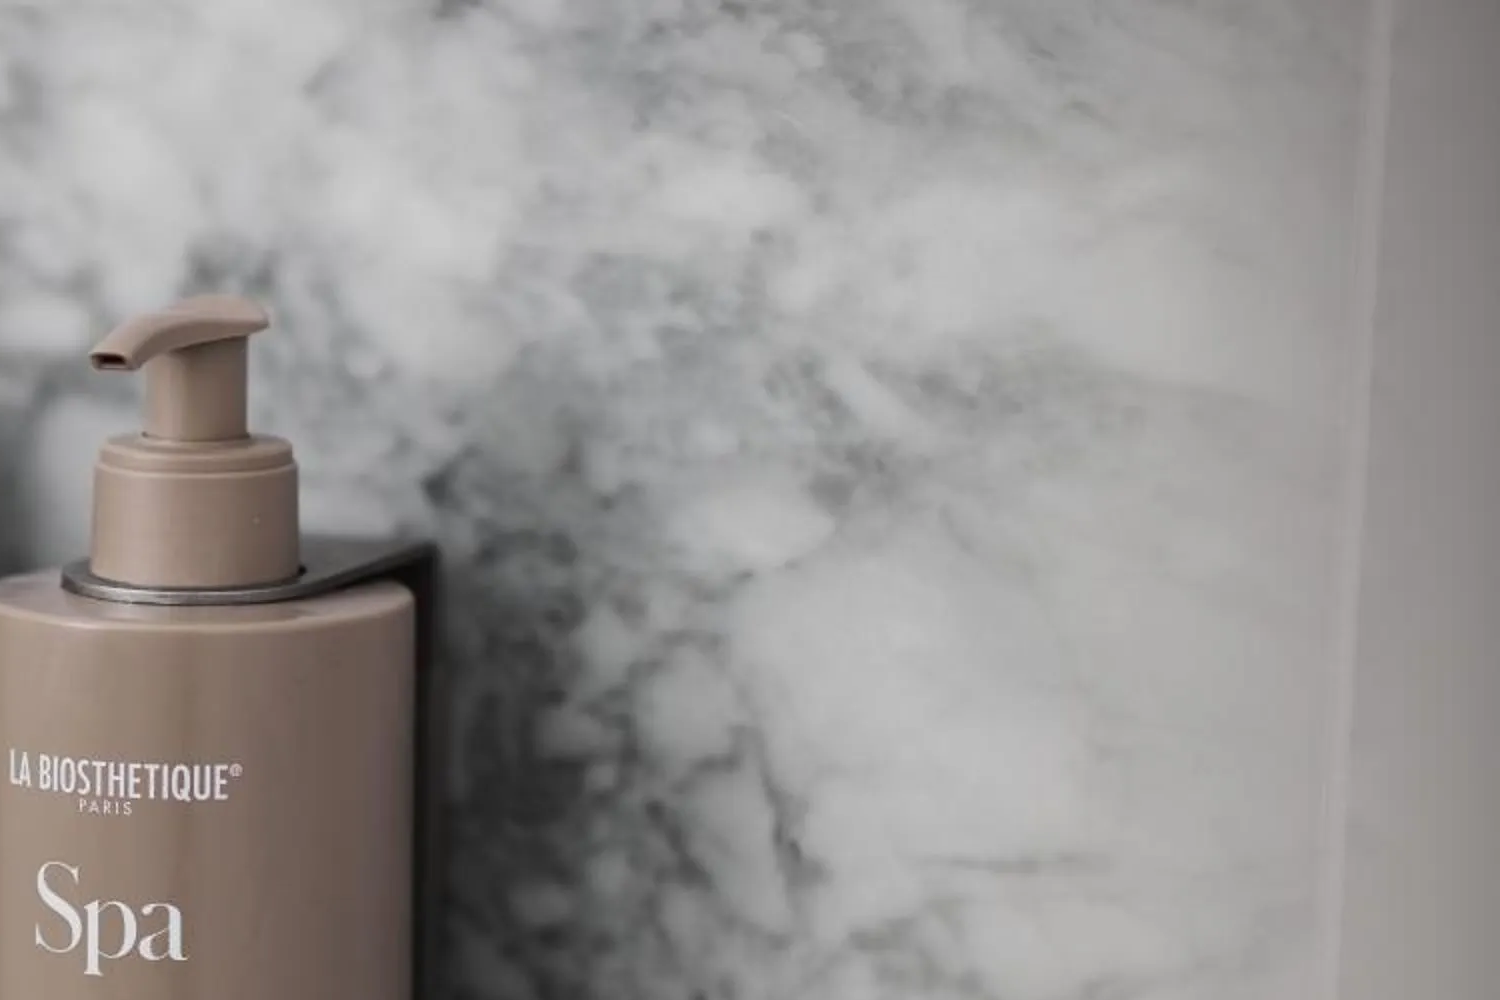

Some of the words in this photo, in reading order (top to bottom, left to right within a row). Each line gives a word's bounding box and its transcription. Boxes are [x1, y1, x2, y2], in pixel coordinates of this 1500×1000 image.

[9, 748, 31, 787] LA
[79, 798, 133, 816] PARIS
[35, 861, 189, 977] Spa
